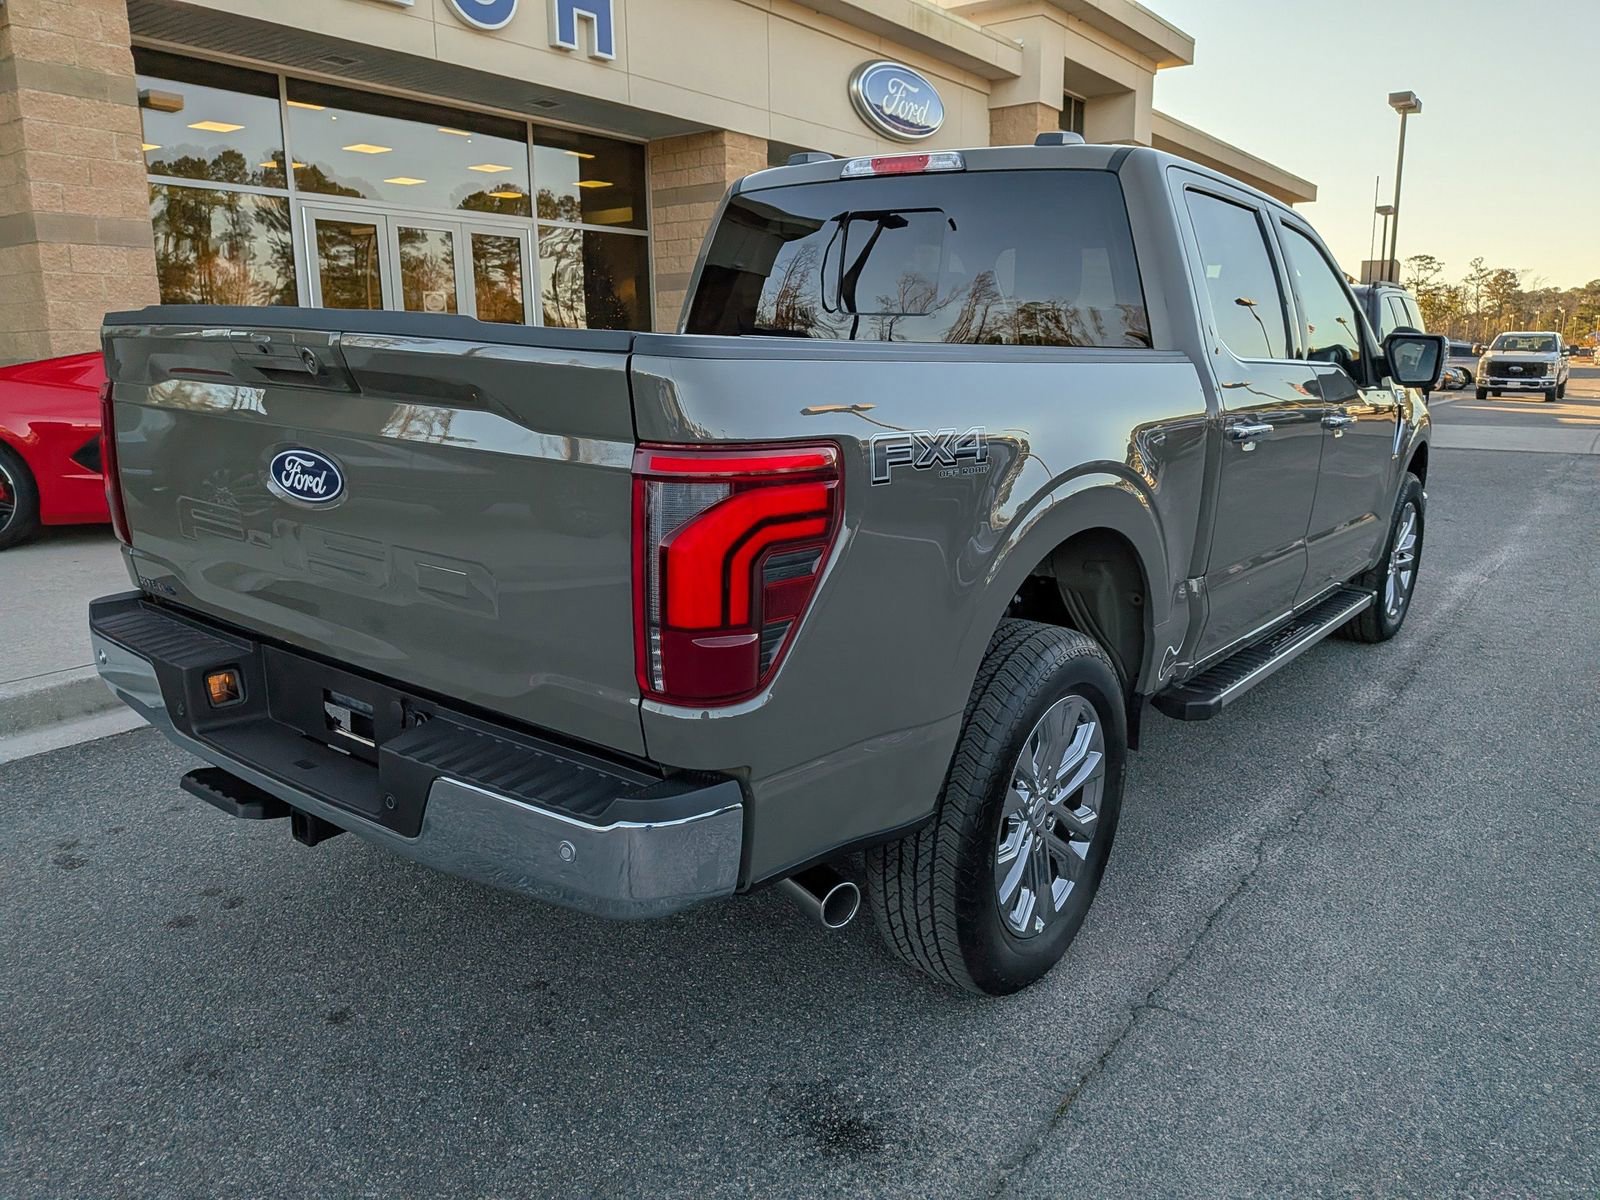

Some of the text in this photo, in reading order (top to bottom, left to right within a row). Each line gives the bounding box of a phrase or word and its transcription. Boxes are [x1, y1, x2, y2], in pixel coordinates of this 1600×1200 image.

[882, 77, 930, 125] Ford
[281, 455, 327, 494] Ford
[869, 426, 989, 486] FX4
[939, 464, 991, 478] OFF ROAD
